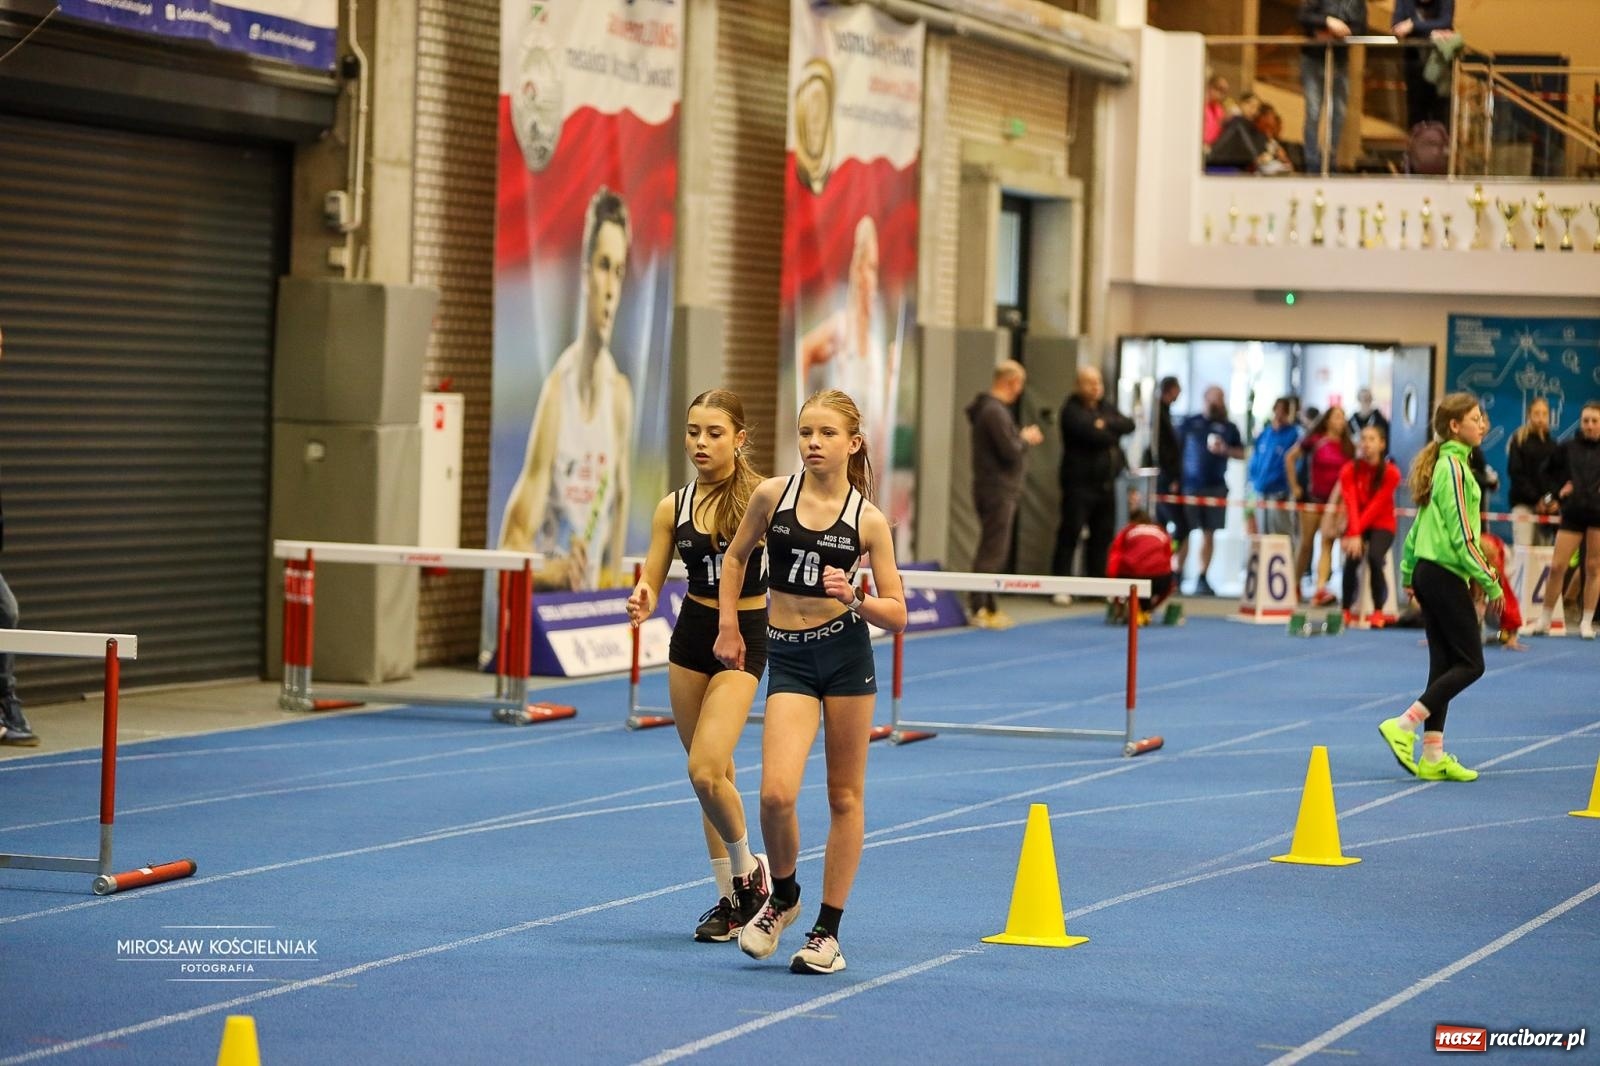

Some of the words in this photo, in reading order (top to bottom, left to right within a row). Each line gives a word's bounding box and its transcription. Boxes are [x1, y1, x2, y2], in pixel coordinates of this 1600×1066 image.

[823, 534, 837, 543] MOS
[838, 536, 851, 545] CSIR
[788, 548, 820, 587] 76
[1268, 554, 1288, 601] 6
[766, 625, 800, 643] NIKE
[803, 620, 844, 643] PRO
